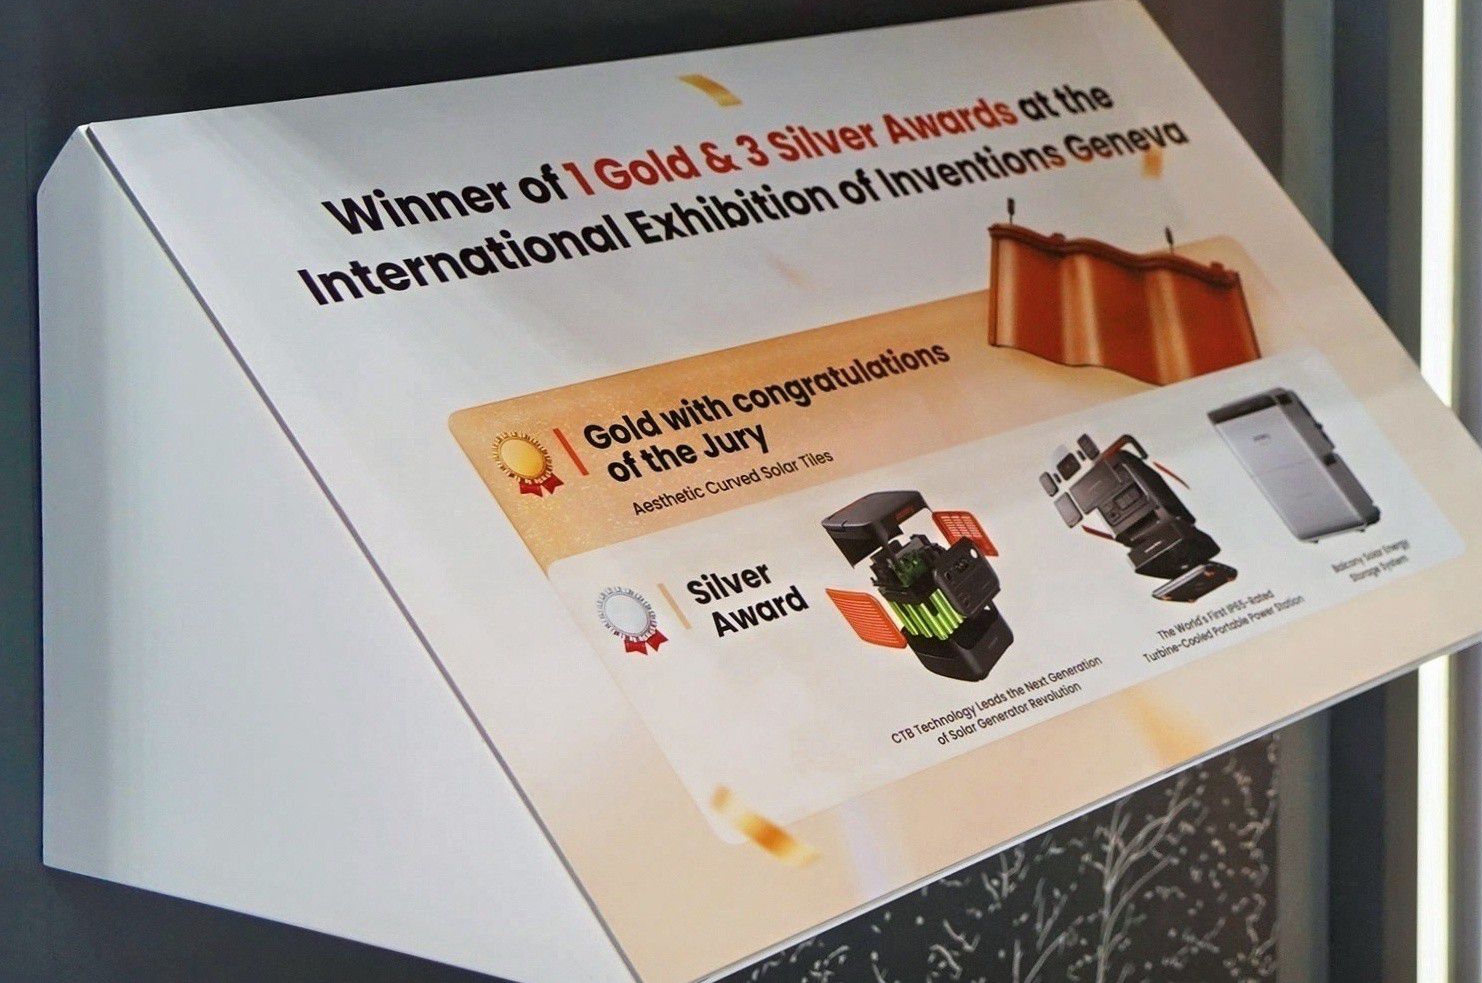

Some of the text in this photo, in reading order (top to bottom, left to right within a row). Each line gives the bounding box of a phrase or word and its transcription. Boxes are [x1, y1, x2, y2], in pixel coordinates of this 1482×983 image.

[321, 85, 1114, 235] Winner of 1 Gold & 3 Silver Awards at the
[297, 121, 1190, 305] International Exhibition of Inventions Geneva
[583, 343, 950, 449] Gold with congratulations
[607, 424, 769, 482] of the Jury
[632, 449, 834, 516] Aesthetic Curved Solar Tiles
[686, 561, 773, 606] Silver
[711, 585, 809, 638] Award
[1143, 595, 1305, 663] Turbine-Cooled Portable Power Station
[1157, 628, 1175, 640] The
[1206, 607, 1227, 621] First
[891, 655, 1102, 744] CTB Technology Leads the Next Generation
[937, 681, 1082, 745] of Solar Generator Revolution
